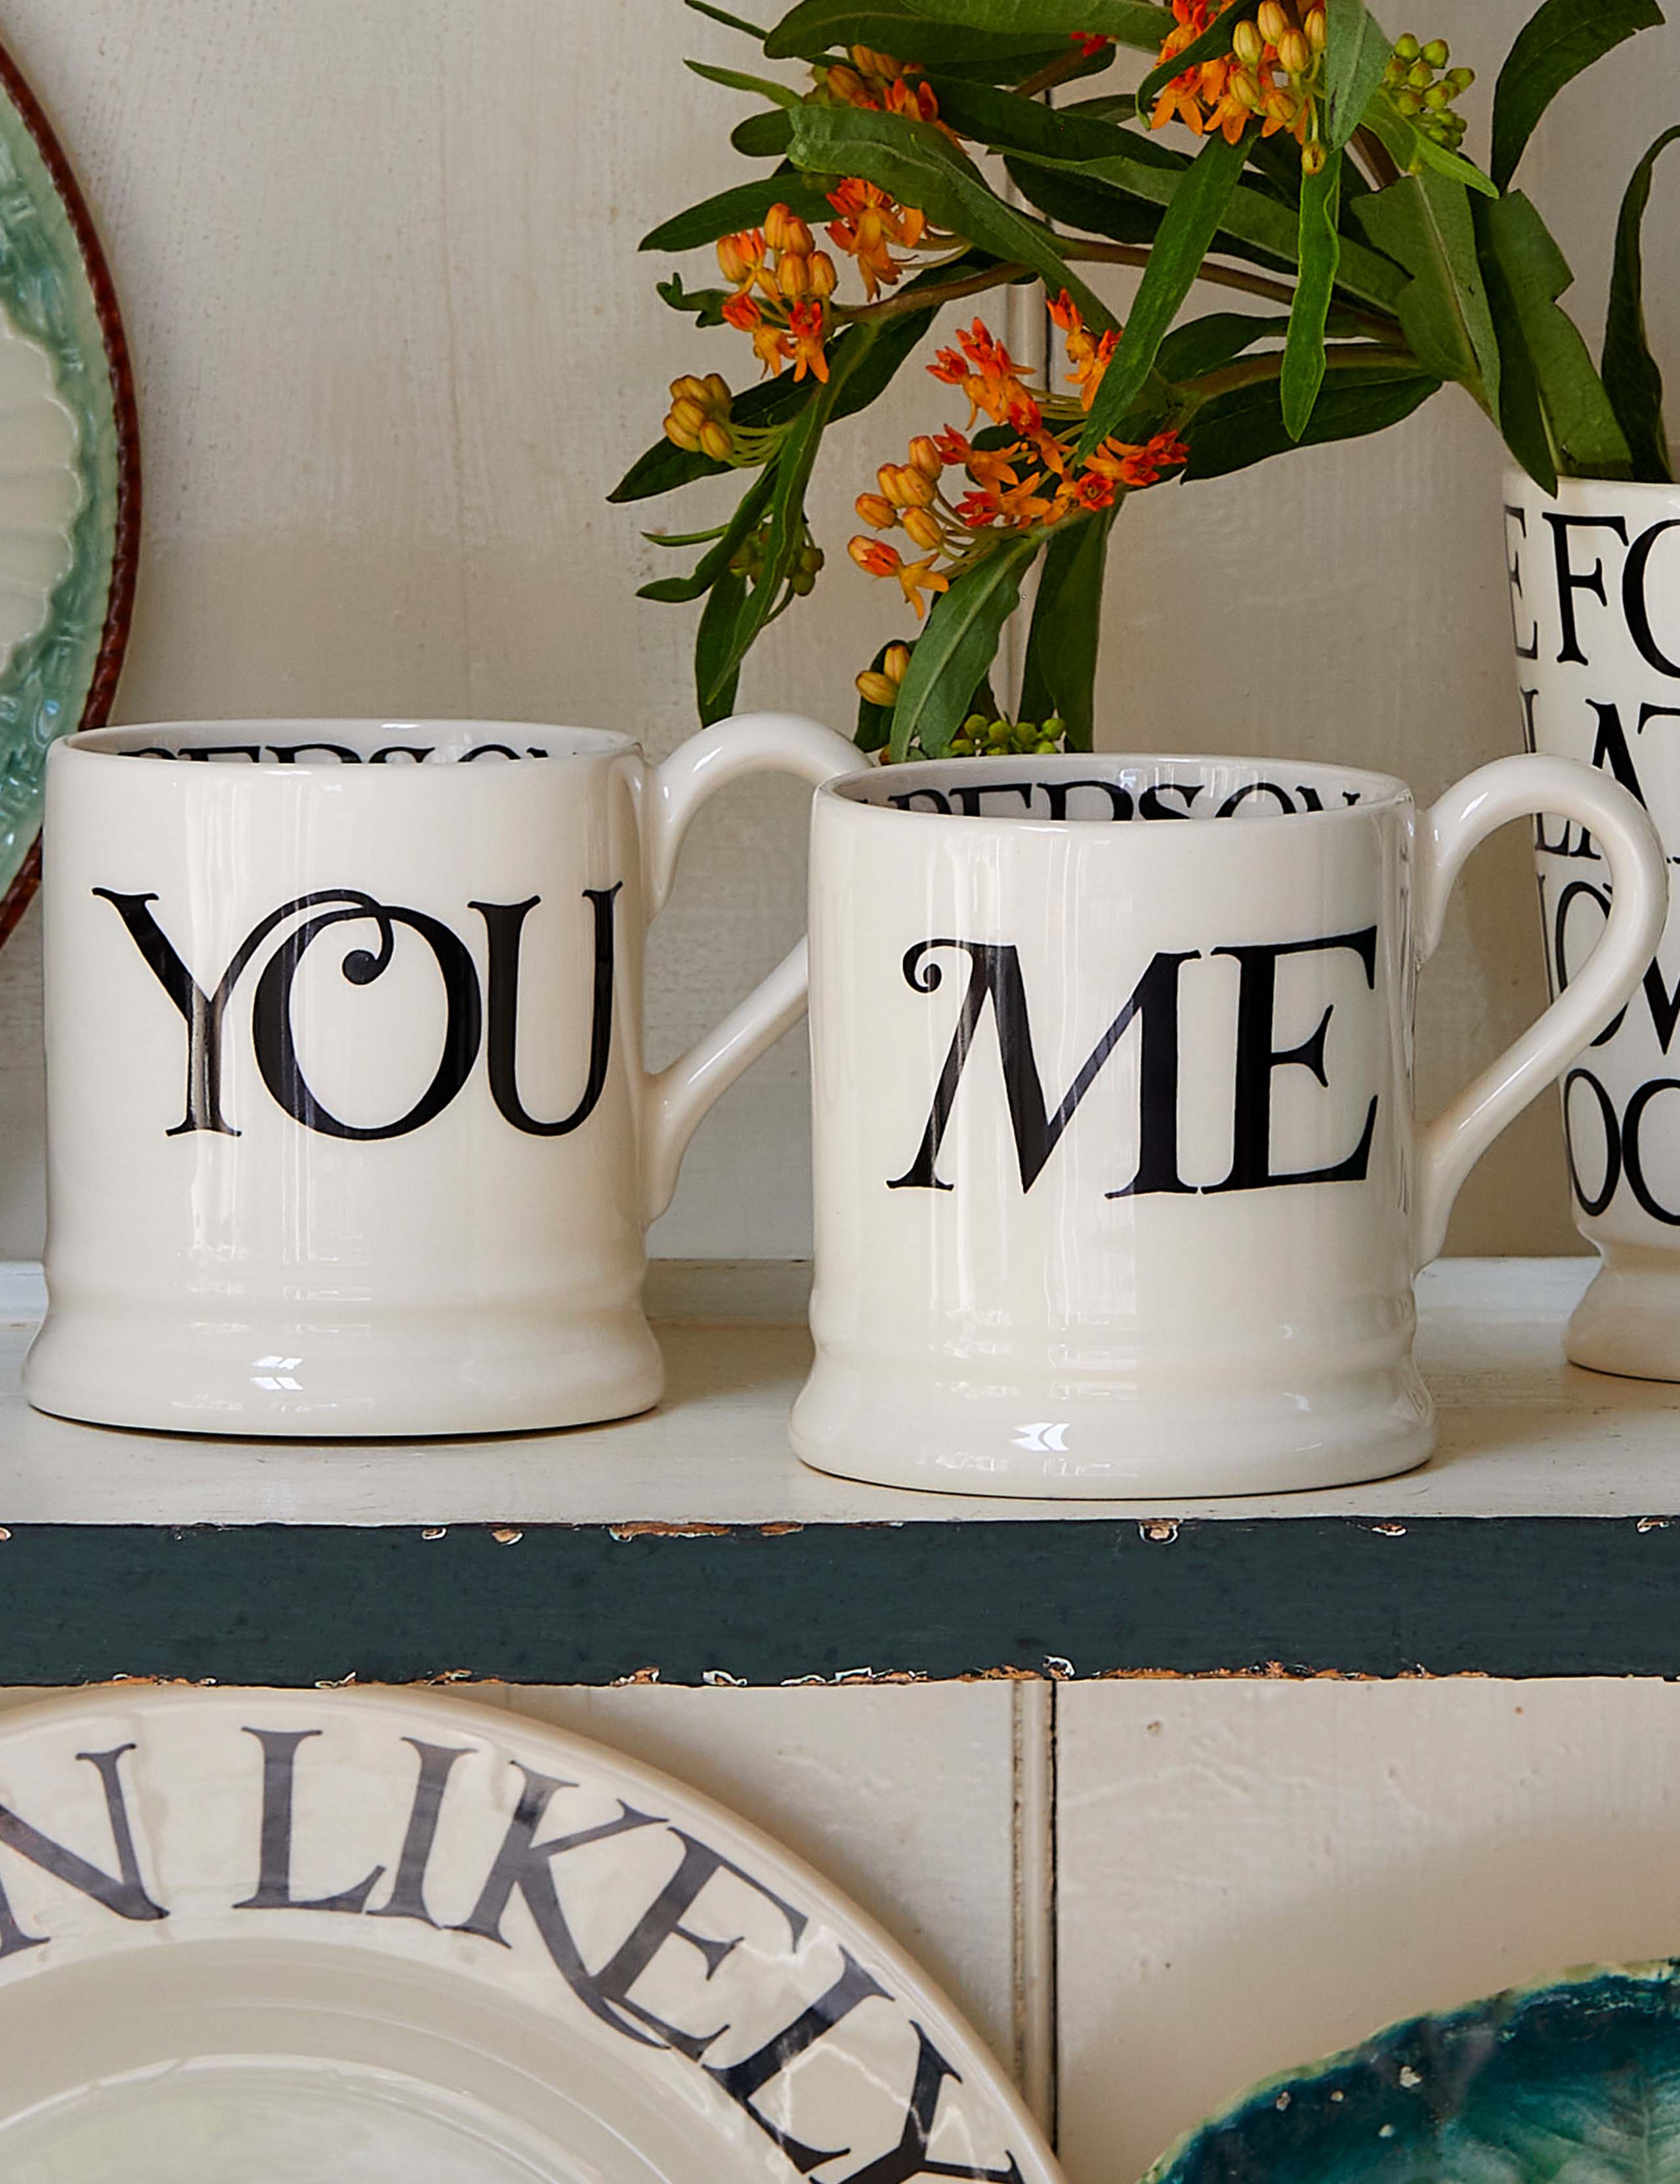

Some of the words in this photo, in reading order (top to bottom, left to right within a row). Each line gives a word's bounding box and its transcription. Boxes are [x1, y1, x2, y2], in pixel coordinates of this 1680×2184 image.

[91, 881, 623, 1141] YOU
[886, 925, 1378, 1200] ME
[232, 1726, 1026, 2184] LIKELY
